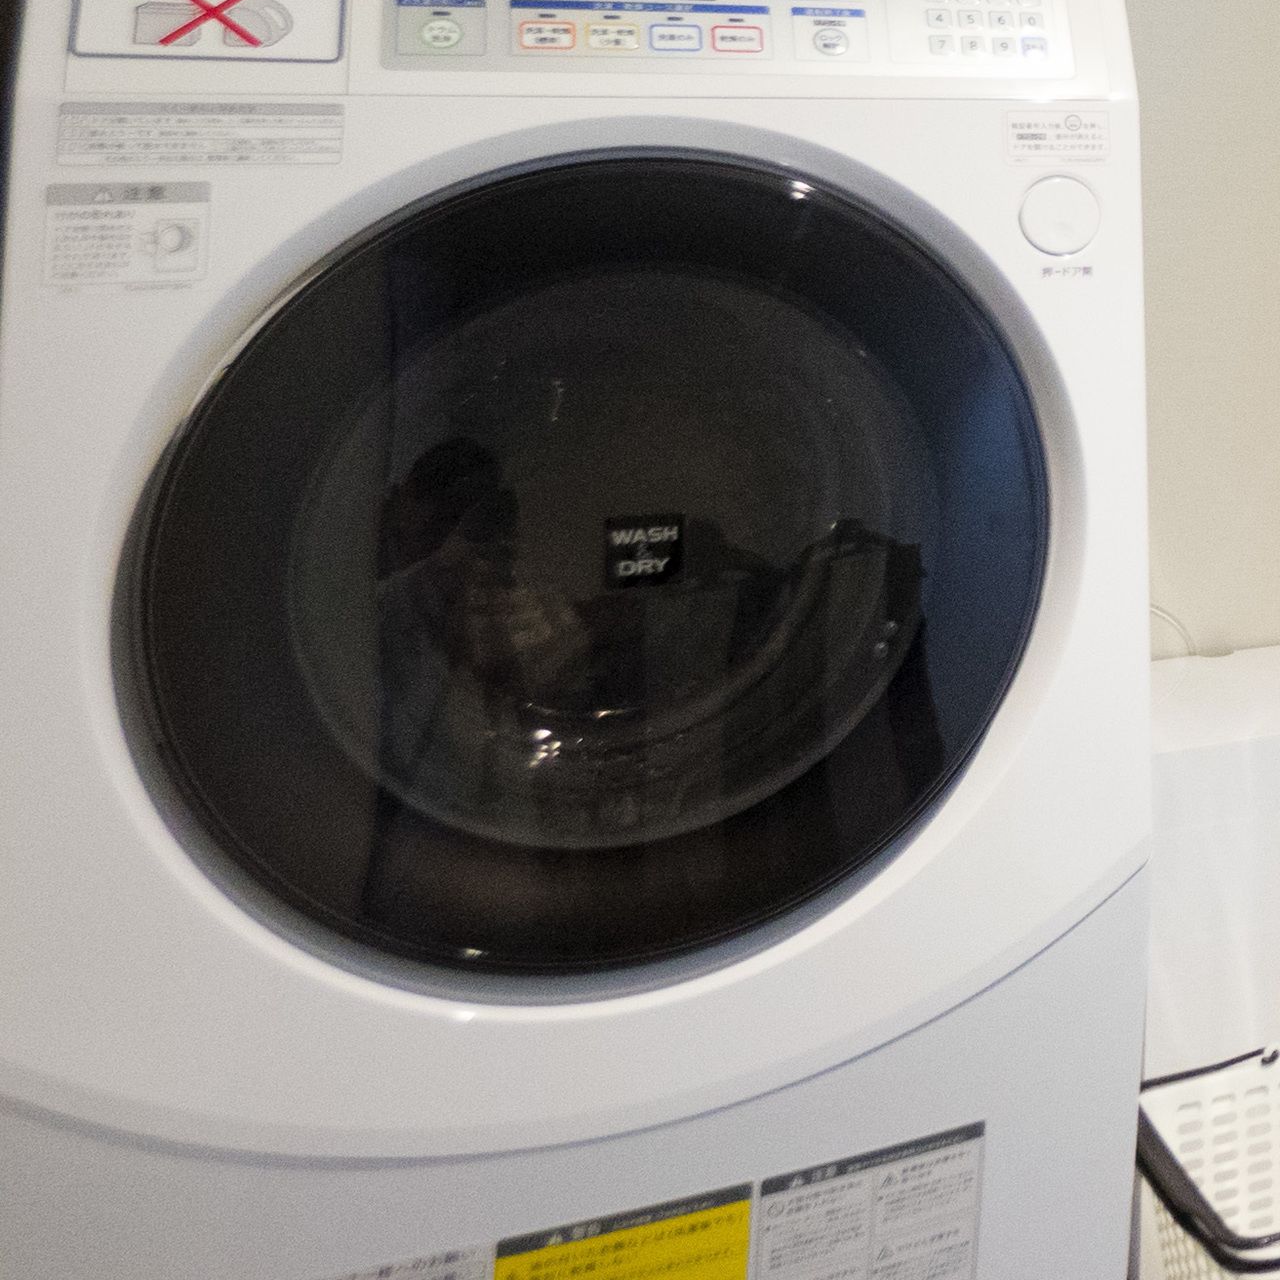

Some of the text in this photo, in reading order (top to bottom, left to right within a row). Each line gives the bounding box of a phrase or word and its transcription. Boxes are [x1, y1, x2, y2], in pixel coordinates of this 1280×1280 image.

[966, 14, 975, 24] 5
[998, 15, 1006, 25] 6
[1028, 16, 1036, 26] 0
[937, 39, 946, 49] 7
[969, 40, 977, 51] 8
[1000, 41, 1008, 52] 9
[612, 525, 679, 546] WASH
[618, 557, 670, 577] DRY
